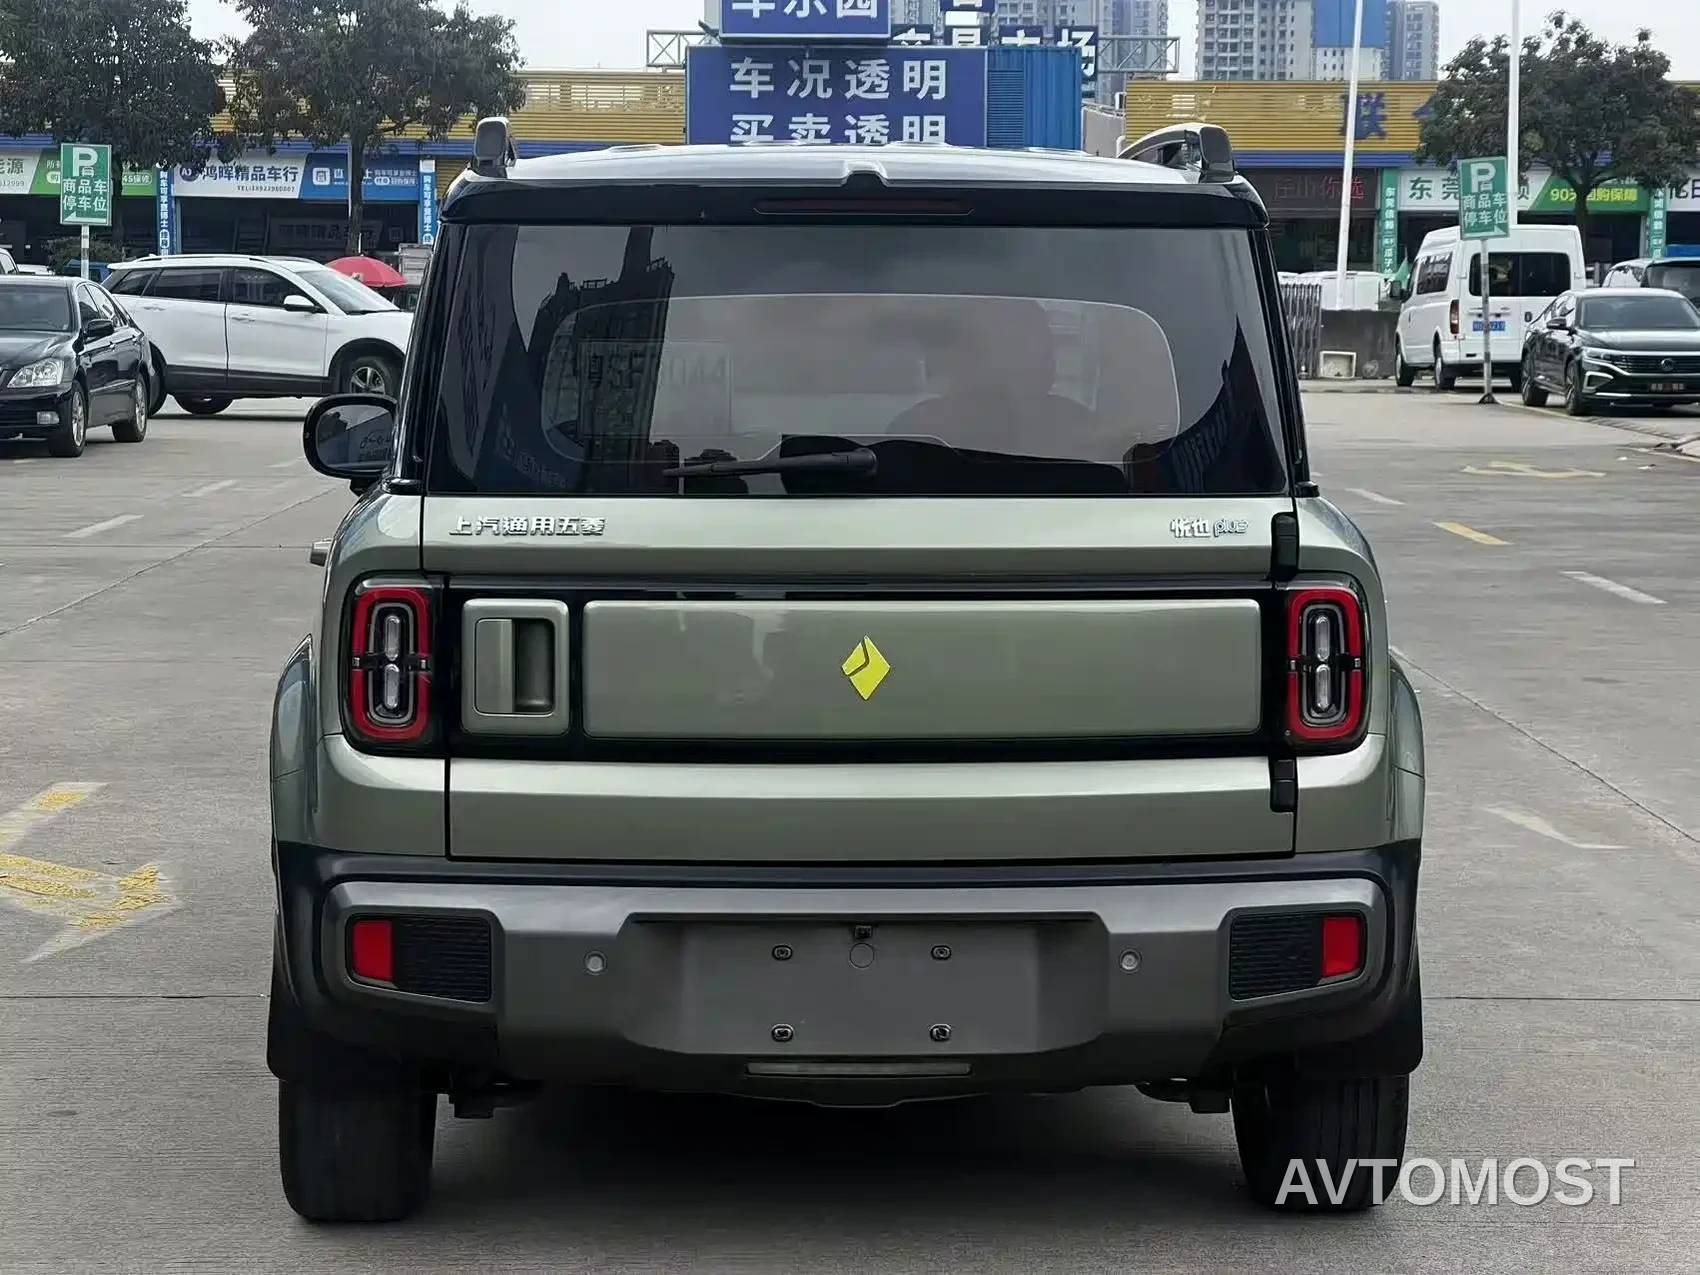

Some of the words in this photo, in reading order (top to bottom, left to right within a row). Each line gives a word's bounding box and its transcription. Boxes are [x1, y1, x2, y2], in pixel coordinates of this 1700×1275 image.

[729, 57, 948, 100] 车况透明
[729, 113, 947, 144] 买卖透明
[73, 147, 98, 177] P
[63, 178, 108, 195] 商品车
[1470, 162, 1497, 193] P
[63, 195, 107, 212] 停车位
[1463, 191, 1507, 210] 商品车
[1464, 209, 1507, 228] 停车位
[449, 515, 606, 537] 上汽通用五菱
[1170, 517, 1211, 538] 悦也
[1213, 518, 1248, 537] plus
